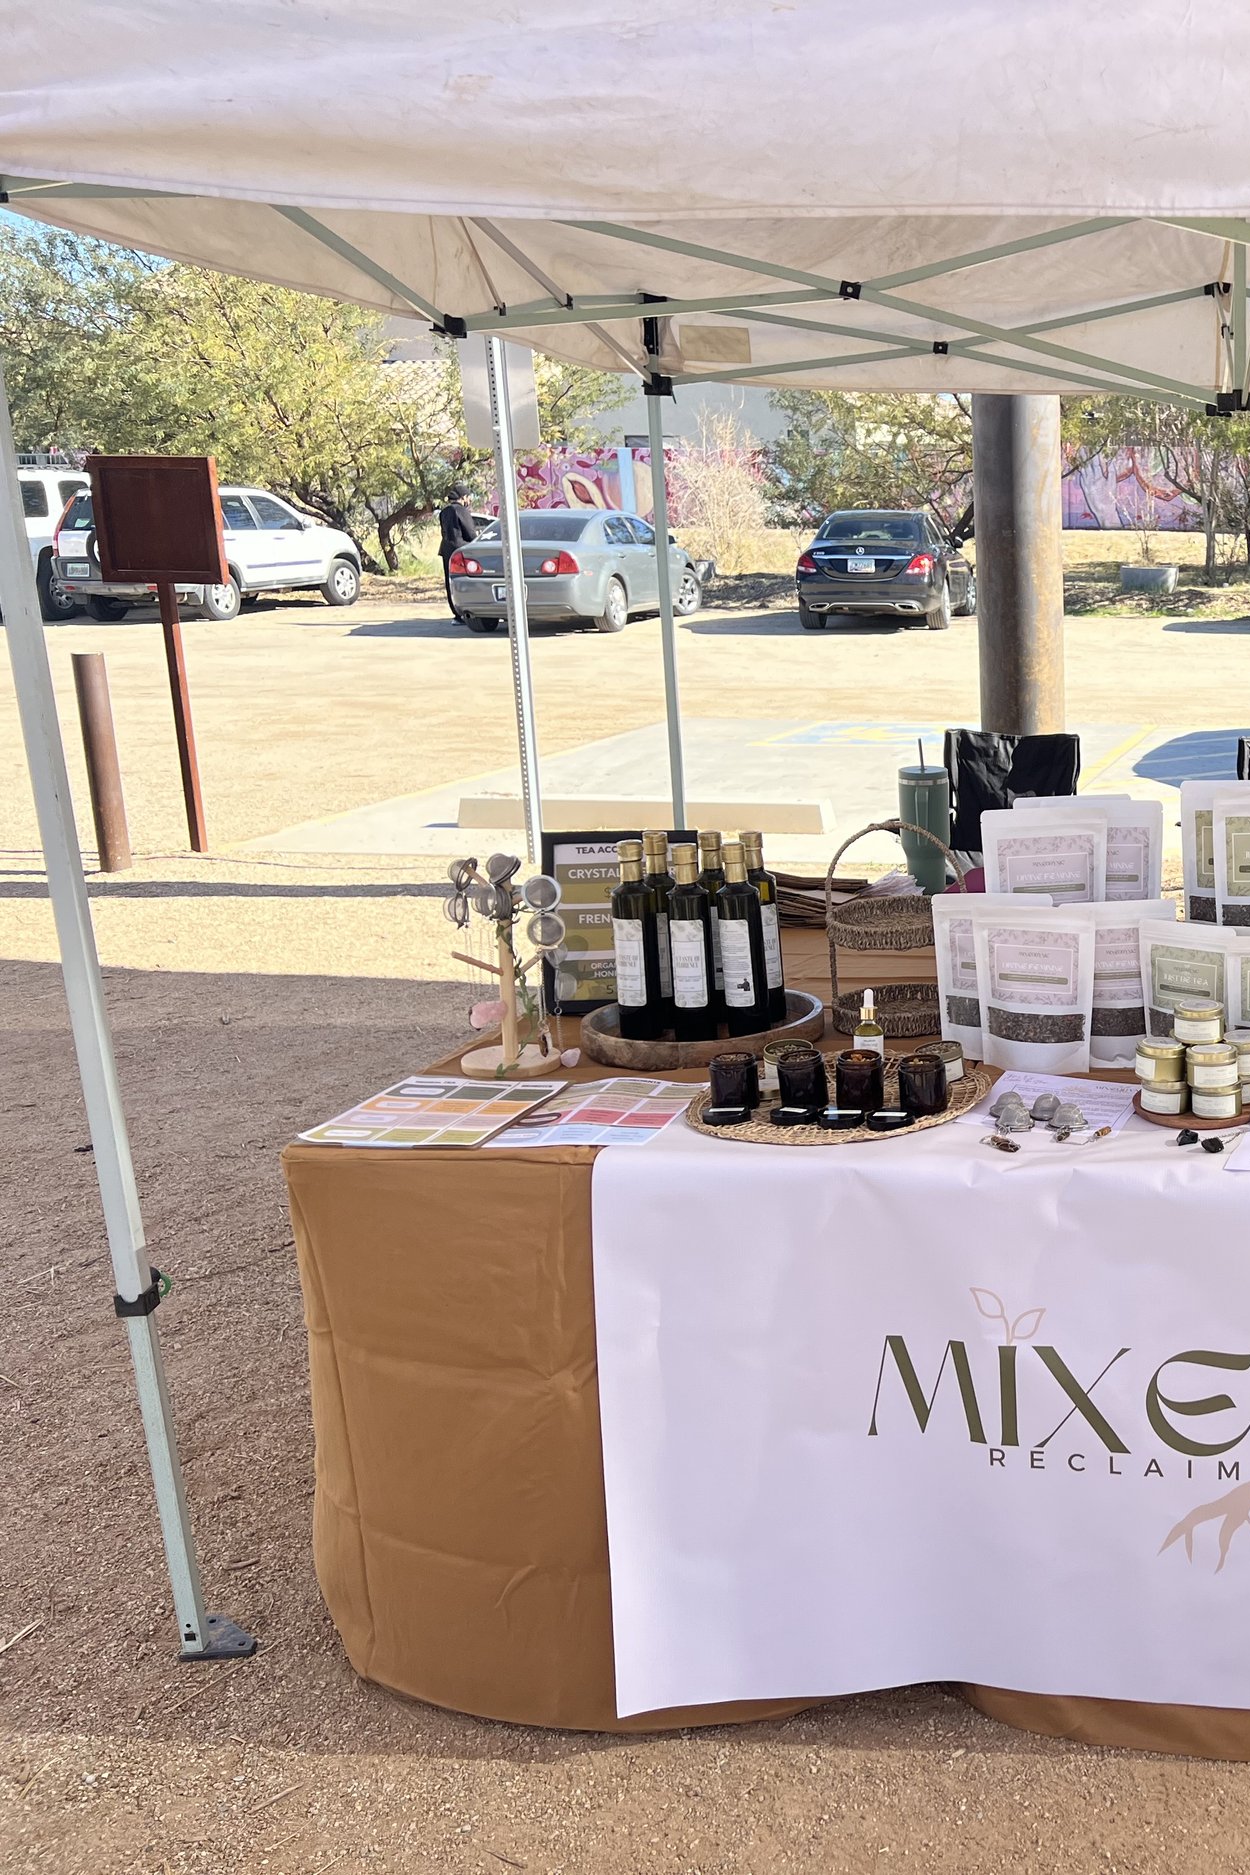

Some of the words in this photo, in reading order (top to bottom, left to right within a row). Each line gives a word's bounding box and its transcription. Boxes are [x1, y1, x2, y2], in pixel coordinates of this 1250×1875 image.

[576, 846, 595, 855] TEA
[568, 868, 621, 880] CRYSTAL
[988, 1447, 1240, 1481] RECLAIM
